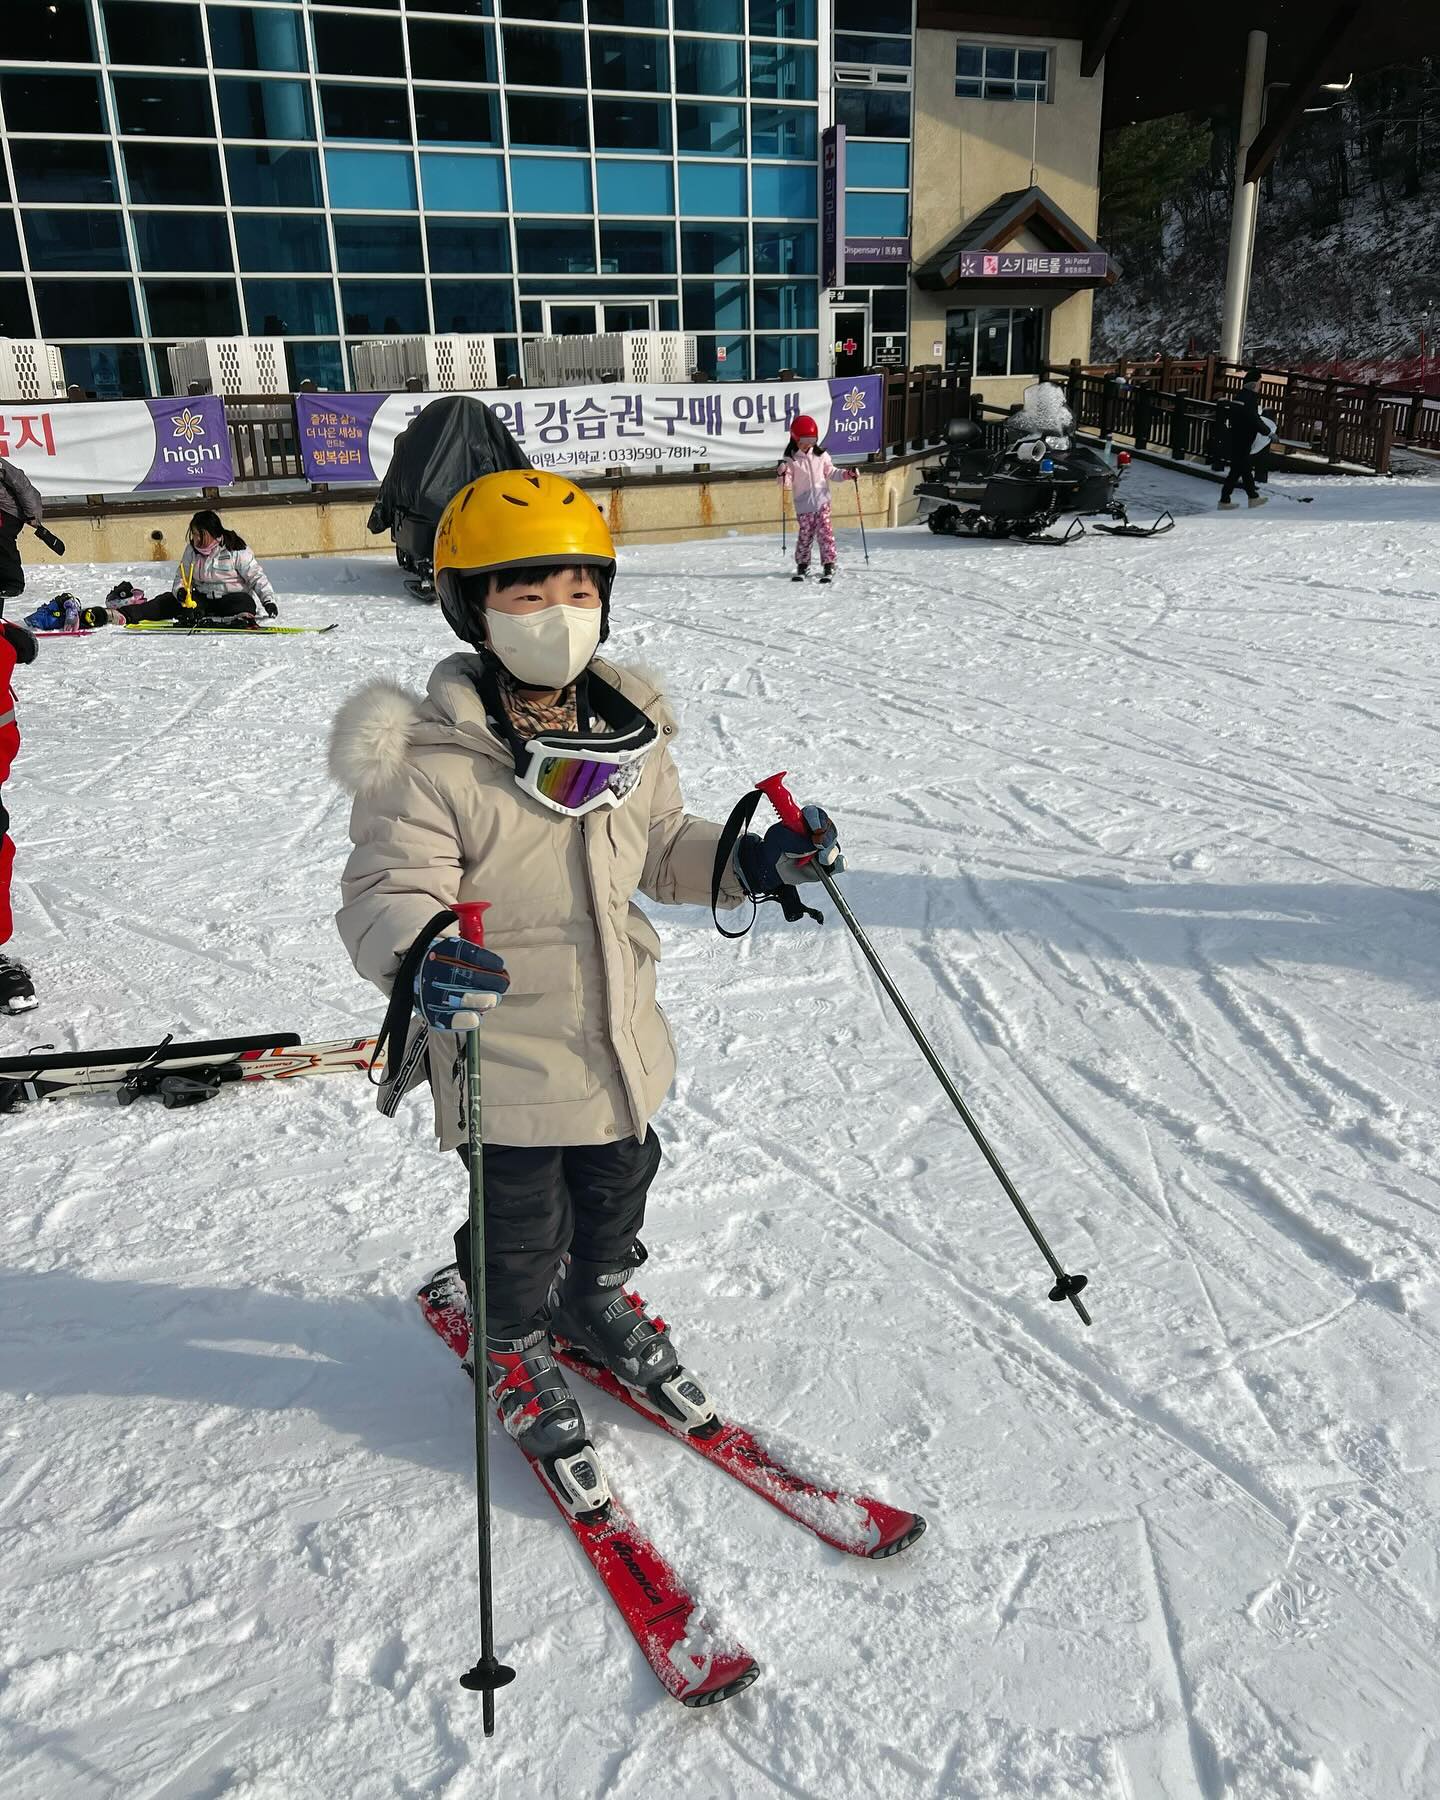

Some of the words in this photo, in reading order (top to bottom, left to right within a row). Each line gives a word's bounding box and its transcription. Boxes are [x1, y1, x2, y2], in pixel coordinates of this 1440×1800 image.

[311, 413, 338, 425] 즐거운
[534, 394, 645, 444] 강습권
[653, 394, 723, 436] 구매
[732, 392, 801, 435] 안내
[834, 416, 874, 434] high1
[0, 413, 56, 458] 지
[306, 427, 316, 439] 더
[317, 427, 336, 439] 나은
[163, 443, 221, 466] high1
[312, 449, 361, 466] 행복쉼터
[609, 1539, 664, 1606] NORDICA
